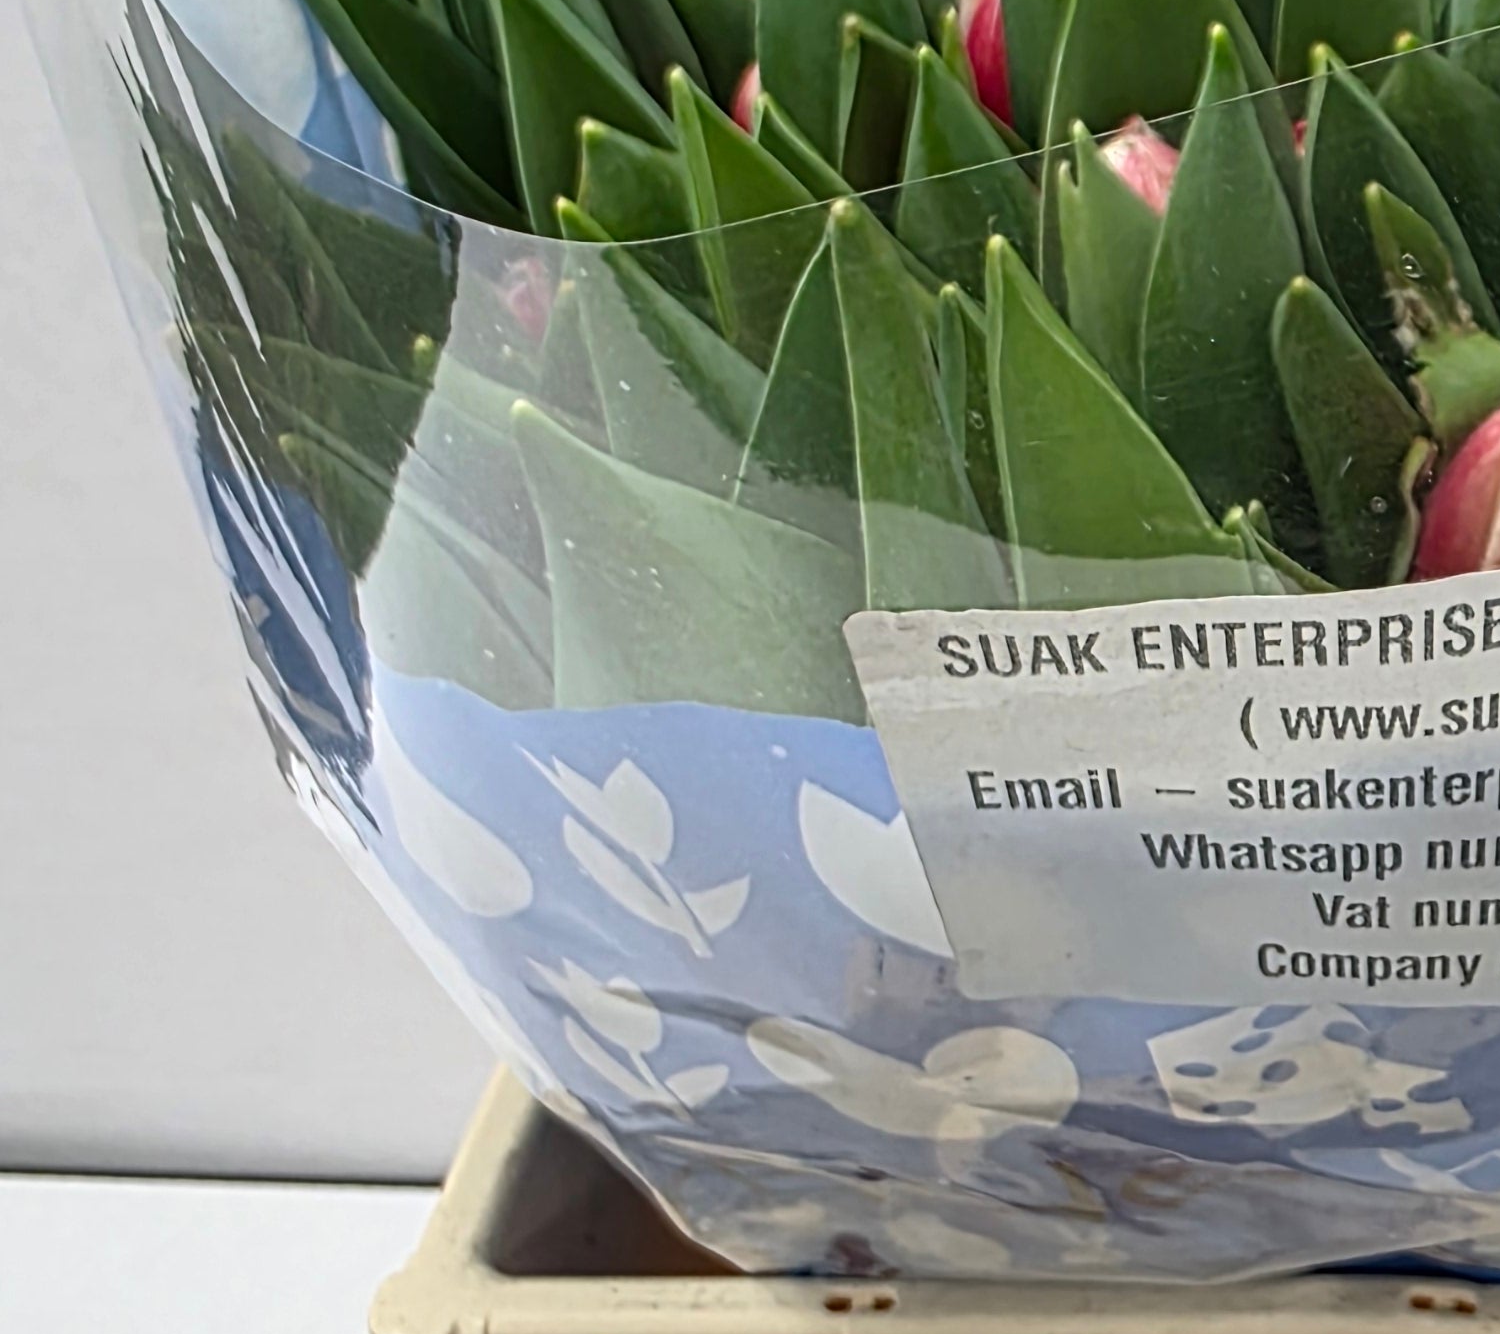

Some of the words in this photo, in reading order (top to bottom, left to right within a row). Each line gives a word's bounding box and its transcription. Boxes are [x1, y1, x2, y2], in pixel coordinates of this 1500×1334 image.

[936, 631, 1108, 678] SUAK
[966, 767, 1122, 811] Email
[1140, 831, 1403, 881] Whatsapp
[1311, 892, 1390, 931] Vat
[1257, 943, 1482, 988] Company
